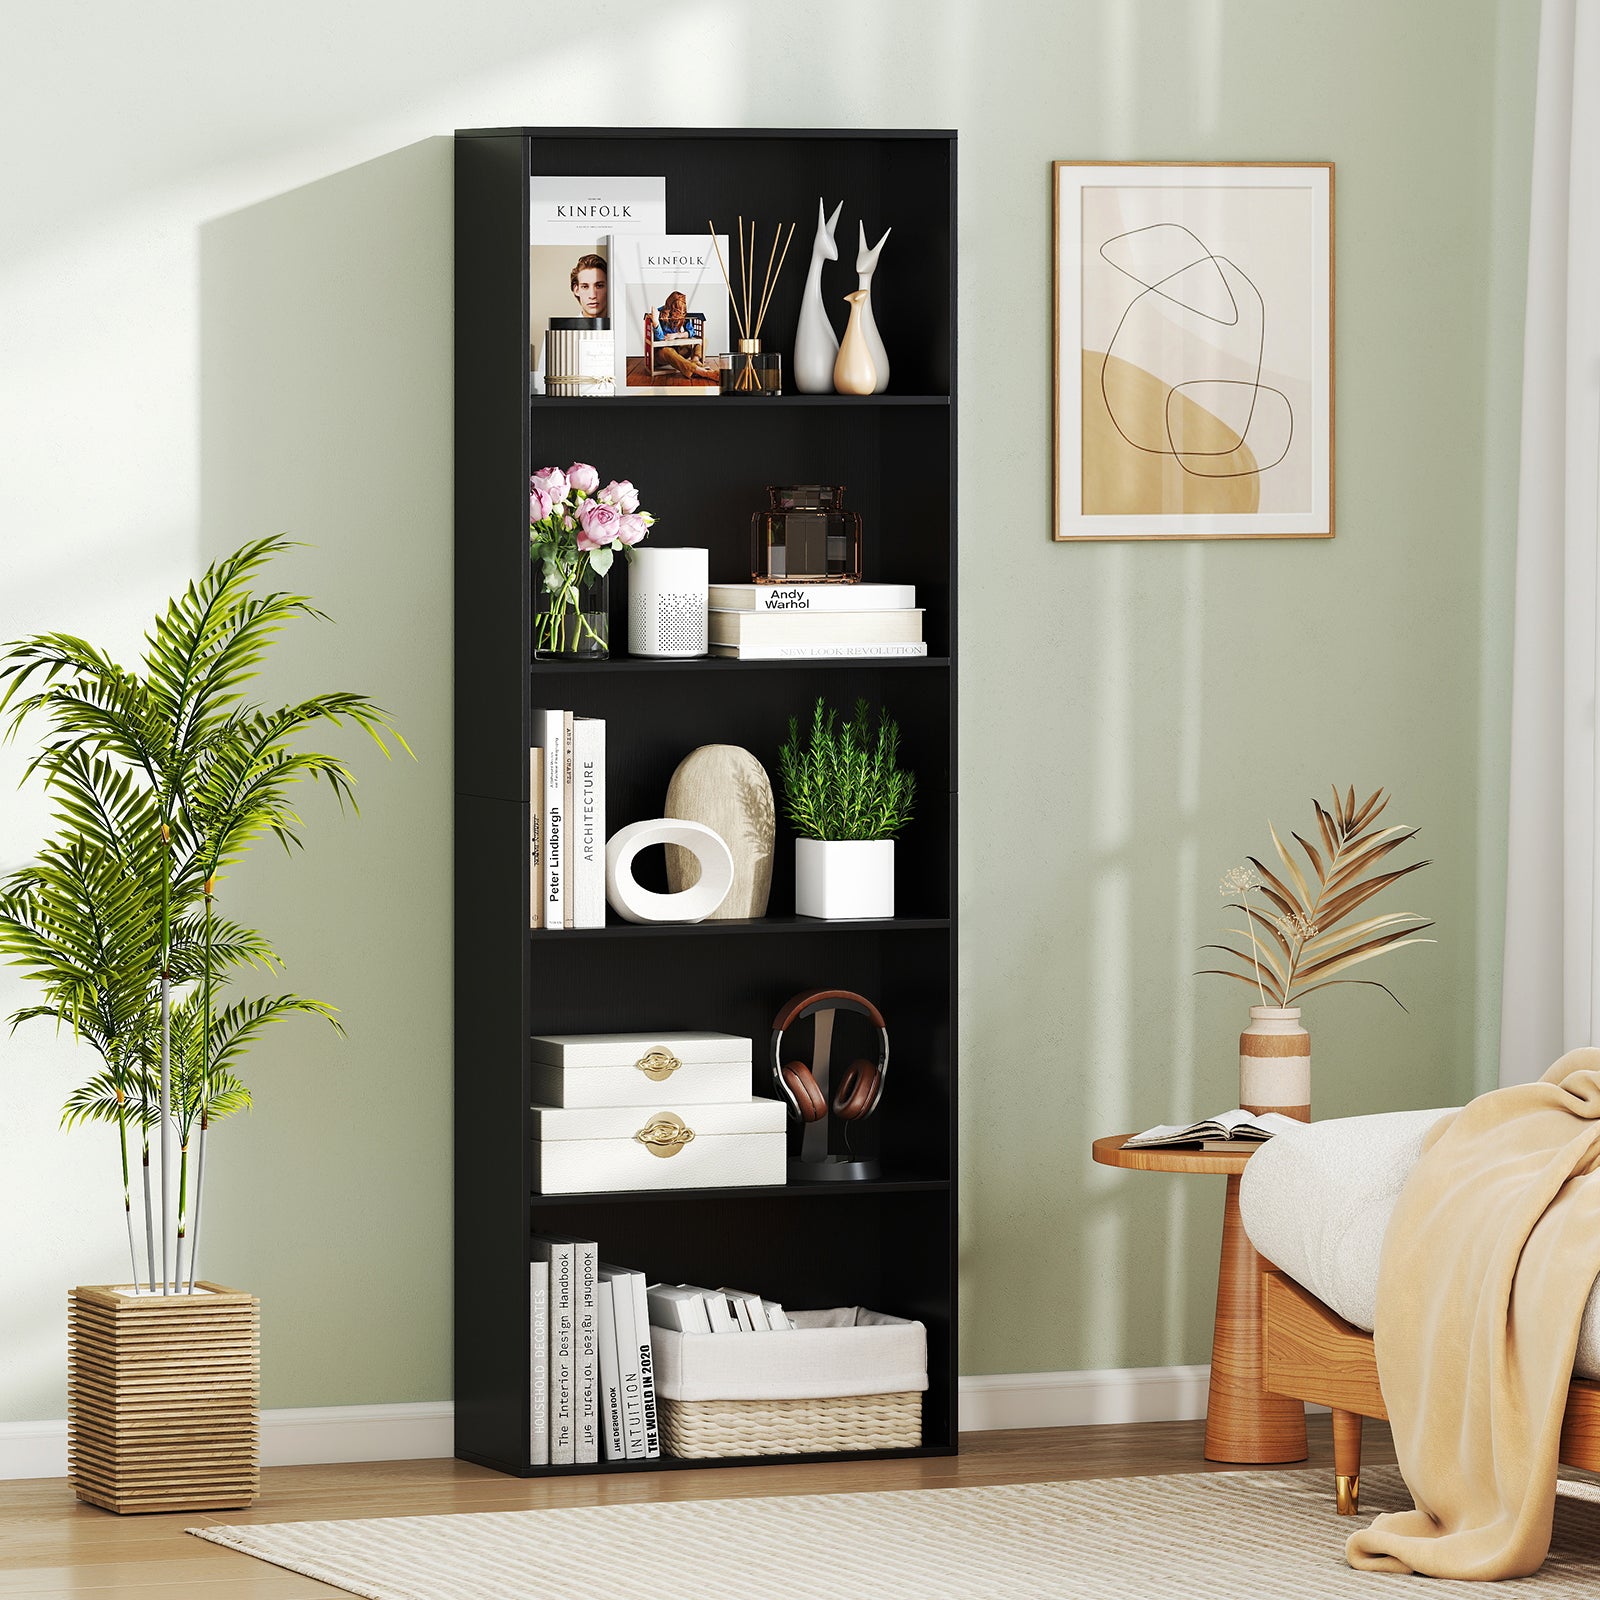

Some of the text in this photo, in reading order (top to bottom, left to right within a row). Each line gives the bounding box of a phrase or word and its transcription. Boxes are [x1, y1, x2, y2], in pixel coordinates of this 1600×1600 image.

[557, 205, 632, 217] KINFOLK
[648, 256, 704, 266] KINFOLK
[765, 599, 810, 609] Warhol
[770, 589, 805, 601] Andy
[780, 645, 923, 656] NEW LOOK REVOLUTION
[583, 761, 594, 862] ARCHITECTURE
[549, 807, 562, 902] Peter Lindbergh
[534, 1289, 545, 1434] HOUSEHOLD DECORATES
[558, 1253, 571, 1447] The Interior Design Handbook
[626, 1373, 643, 1454] INTUITION
[640, 1345, 658, 1454] THE WORLD IN 2020
